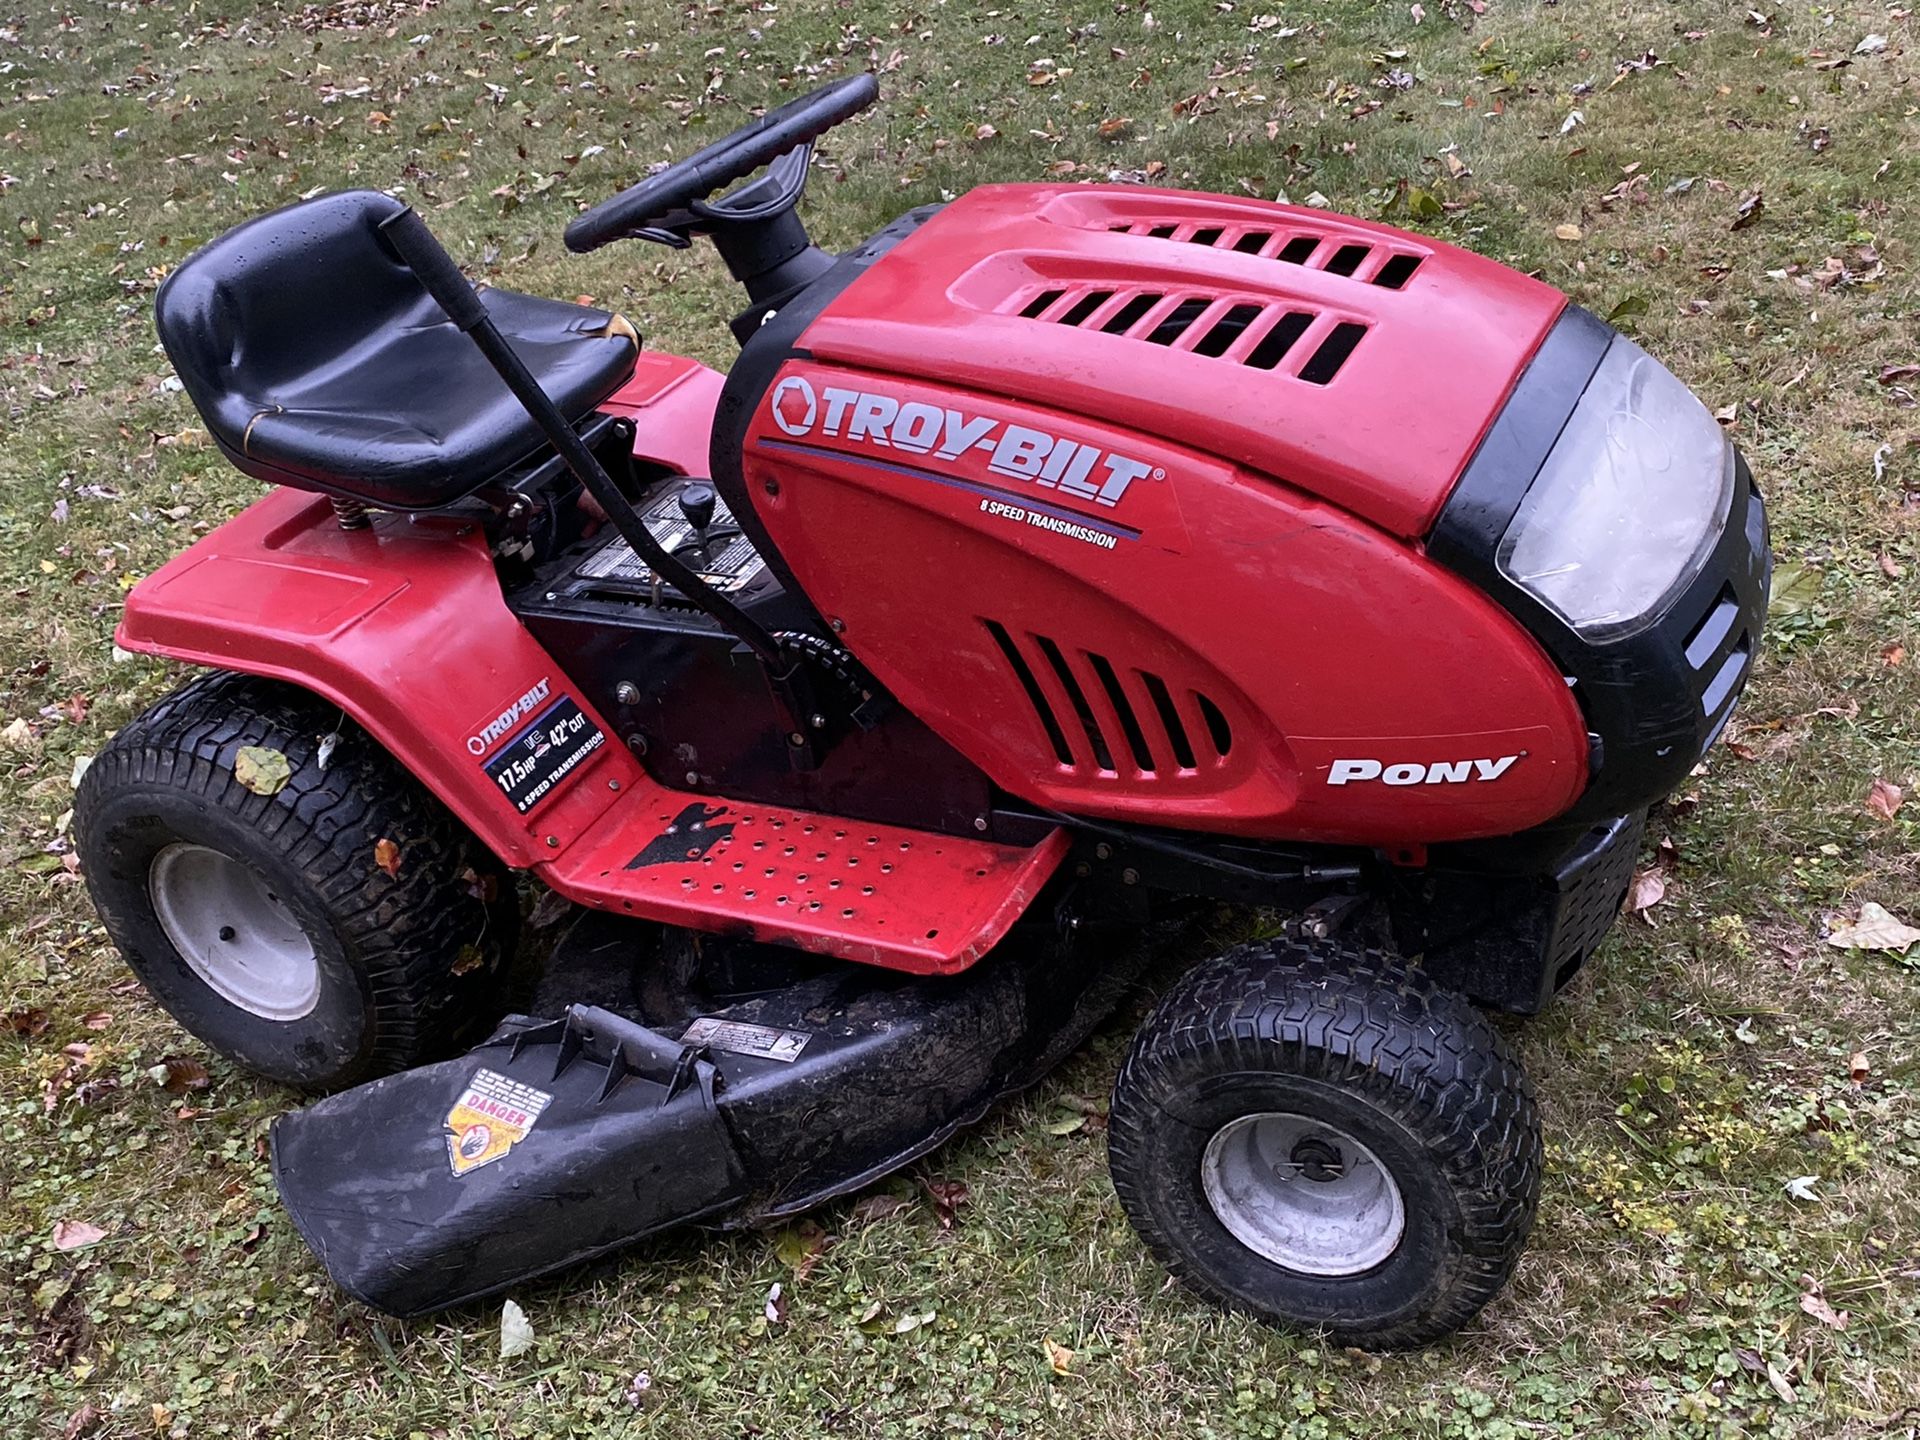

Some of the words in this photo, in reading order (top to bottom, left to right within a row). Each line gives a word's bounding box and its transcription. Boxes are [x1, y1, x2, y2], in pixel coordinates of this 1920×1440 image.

[822, 387, 1153, 508] TROY-BILT
[979, 498, 989, 512] 8
[988, 501, 1026, 522] SPEED
[1026, 511, 1117, 550] TRANSMISSION
[479, 678, 551, 746] TROY-BILT
[568, 712, 586, 733] CUT
[517, 801, 527, 811] 8
[524, 781, 550, 806] SPEED
[549, 730, 605, 784] TRANSMISSION
[1327, 755, 1519, 786] PONY
[467, 1093, 528, 1128] DANGER
